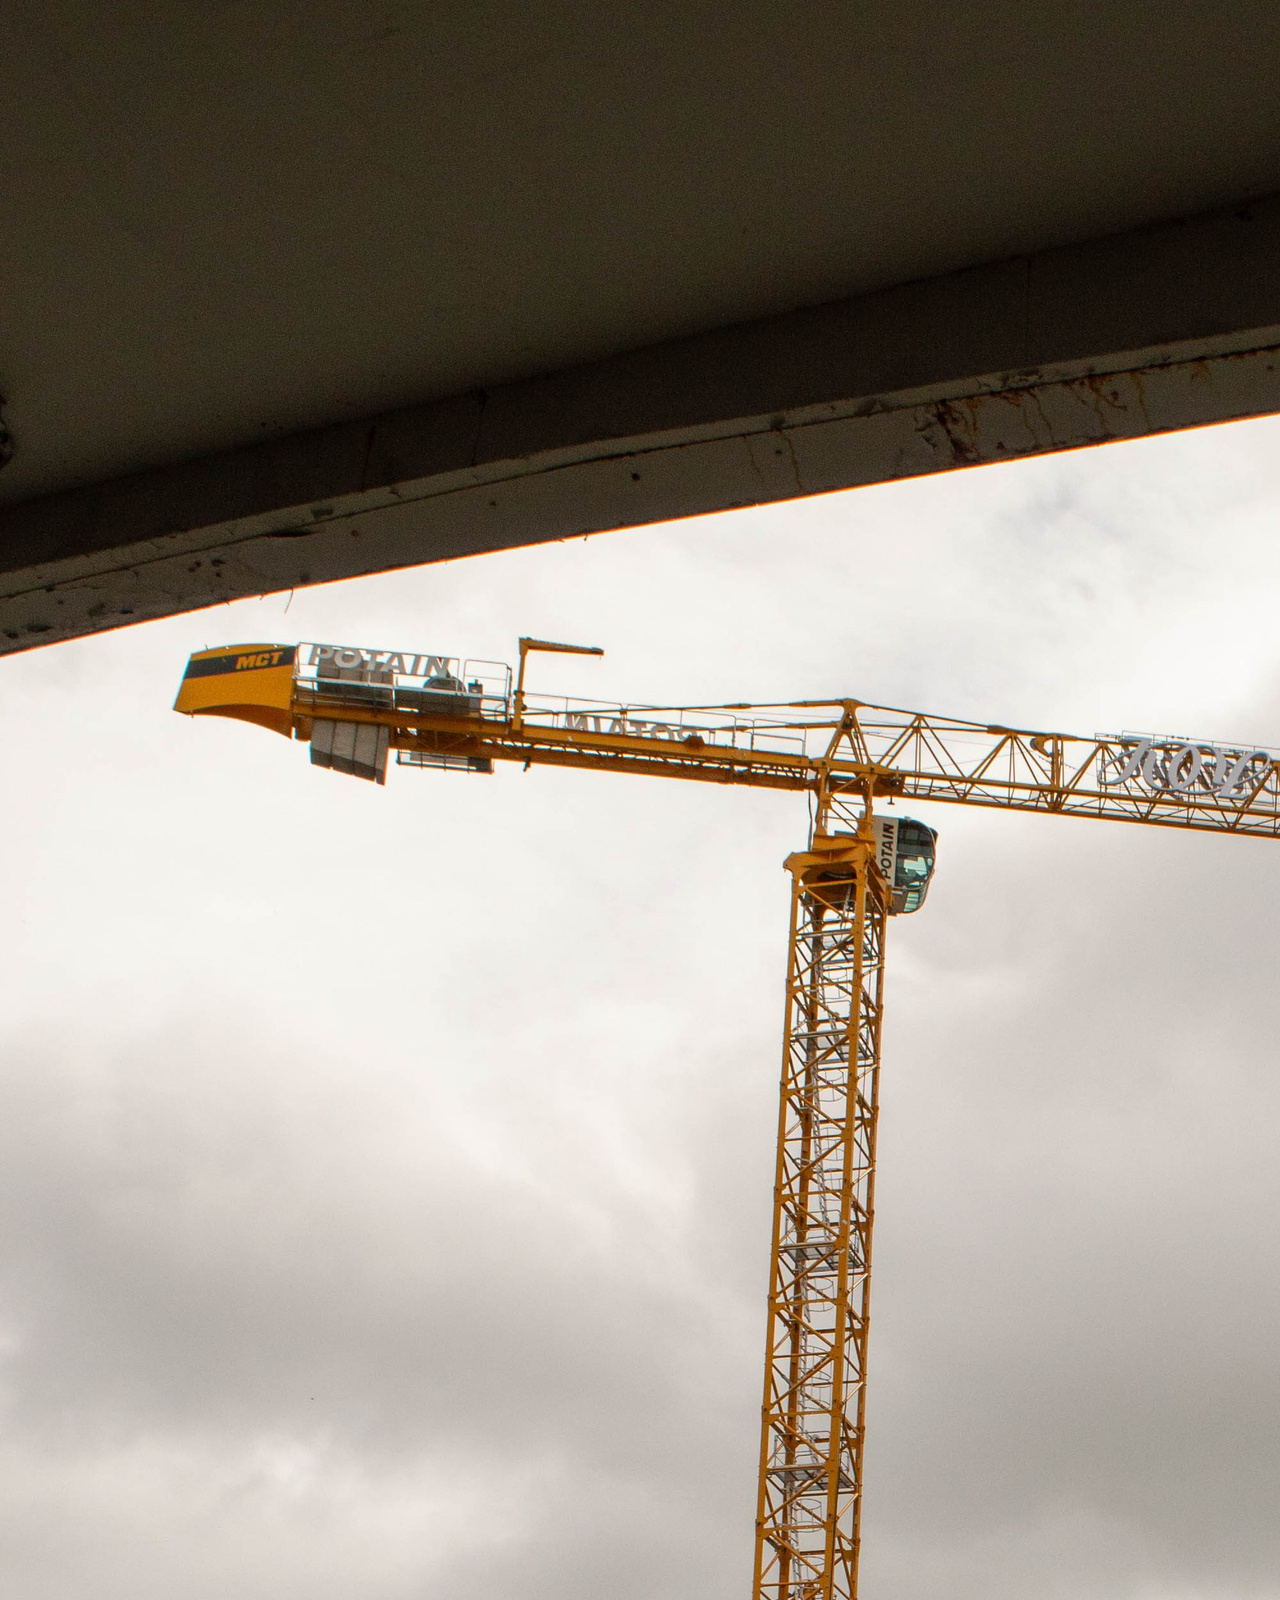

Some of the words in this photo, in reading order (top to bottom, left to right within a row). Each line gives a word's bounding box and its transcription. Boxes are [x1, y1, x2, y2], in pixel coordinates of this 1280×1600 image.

[234, 651, 284, 670] MCT
[309, 645, 451, 678] POTAIN
[880, 822, 894, 880] POTAIN
